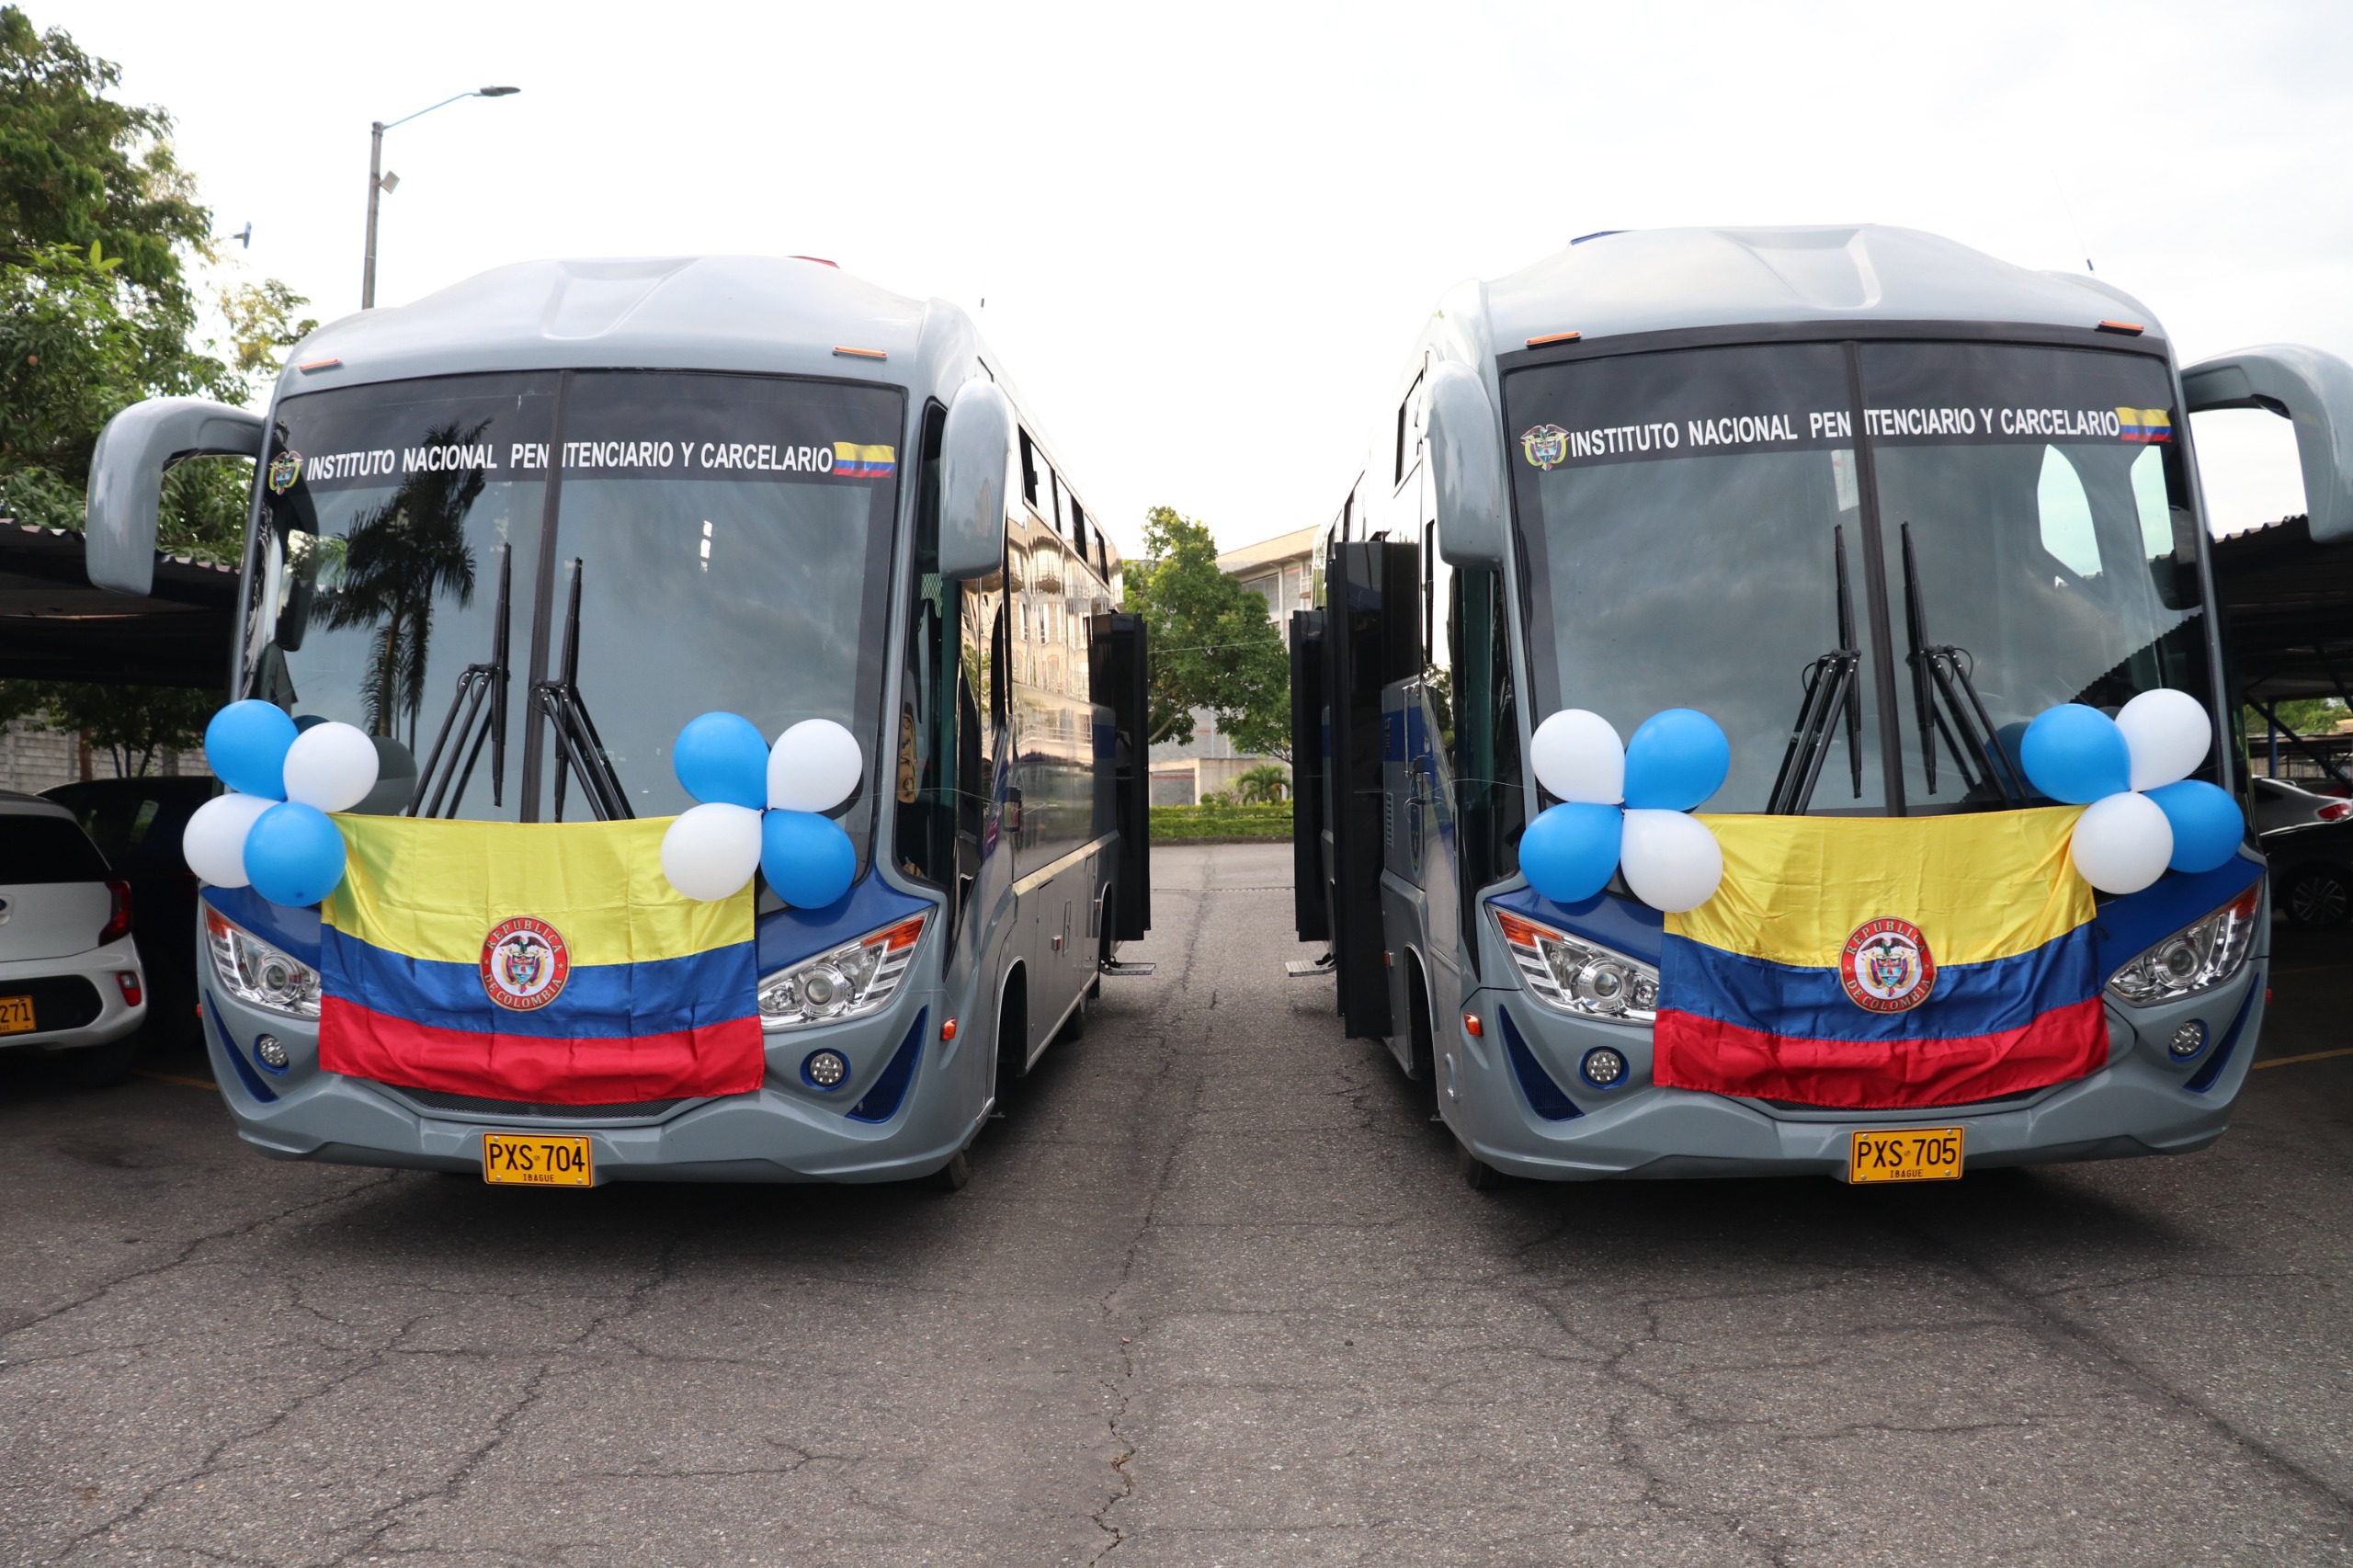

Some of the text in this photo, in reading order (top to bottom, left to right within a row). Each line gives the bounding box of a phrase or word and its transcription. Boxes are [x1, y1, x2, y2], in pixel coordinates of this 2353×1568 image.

[1571, 422, 1679, 458] INSTITUTO
[1688, 415, 1798, 446] NACIONAL
[1980, 408, 1994, 434] Y
[2000, 408, 2120, 437] CARCELARIO
[306, 449, 395, 482] INSTITUTO
[402, 444, 497, 472] NACIONAL
[680, 442, 695, 468] Y
[700, 442, 833, 472] CARCELARIO
[485, 919, 563, 953] REPUBLICA
[1846, 920, 1927, 956] REPUBLICA
[484, 974, 563, 1008] DE COLOMBIA
[1846, 978, 1930, 1011] DE COLOMBIA
[489, 1142, 585, 1173] PXS 704
[1857, 1137, 1958, 1169] PXS 705
[523, 1173, 555, 1183] IBAGUE
[1890, 1168, 1923, 1178] IBAGUE
